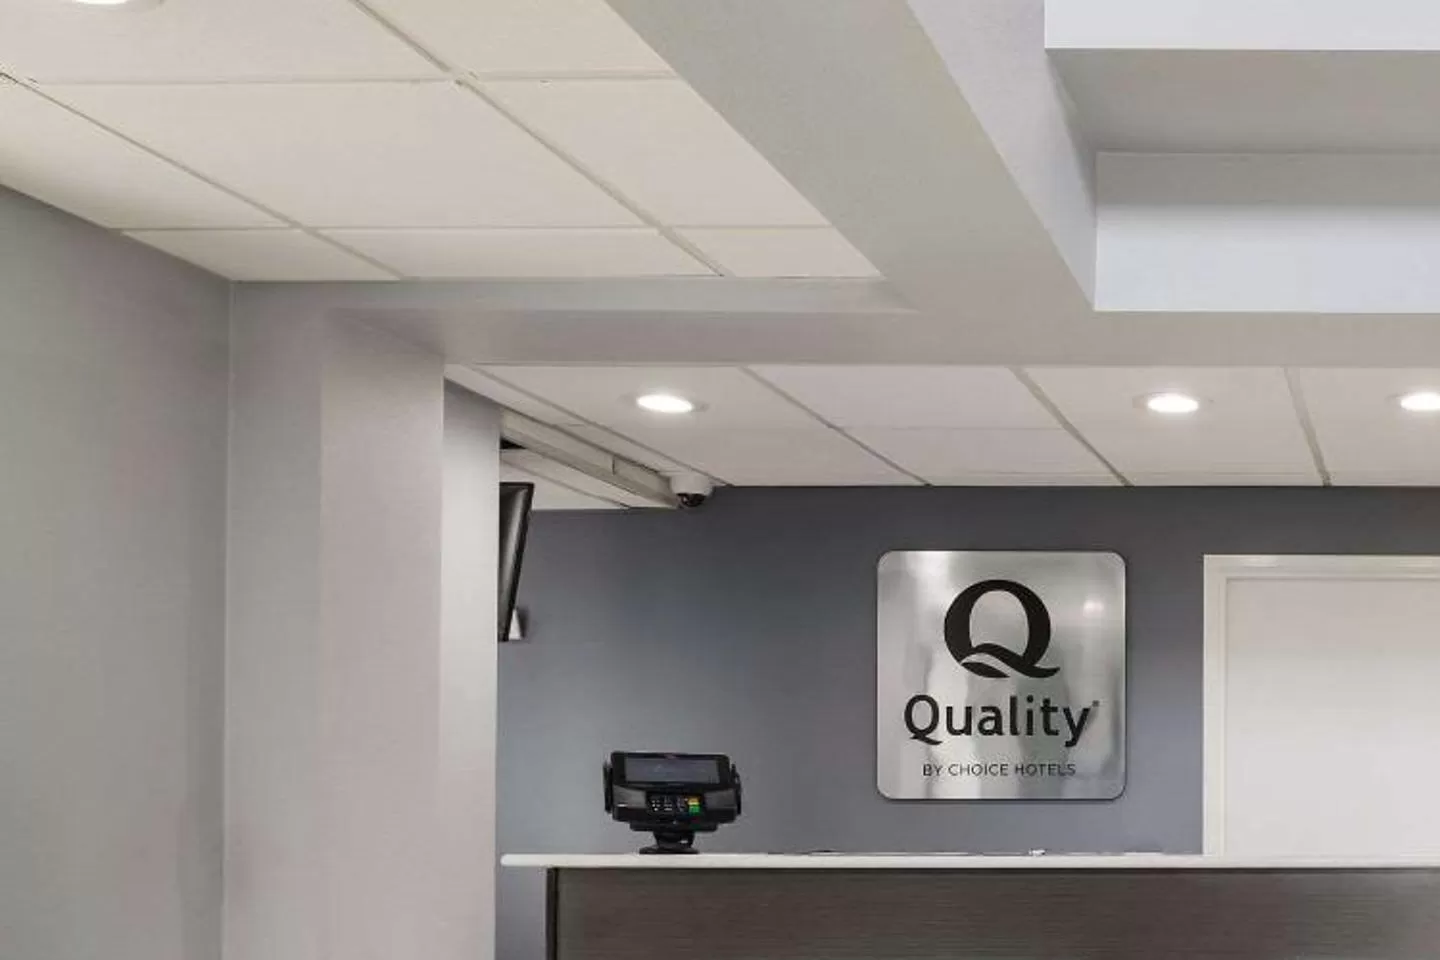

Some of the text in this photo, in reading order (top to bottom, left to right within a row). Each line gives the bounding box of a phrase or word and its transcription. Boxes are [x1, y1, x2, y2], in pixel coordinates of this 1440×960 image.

[944, 579, 1060, 678] Q
[904, 694, 1092, 748] Quality
[922, 763, 1077, 777] BY CHOICE HOTELS
